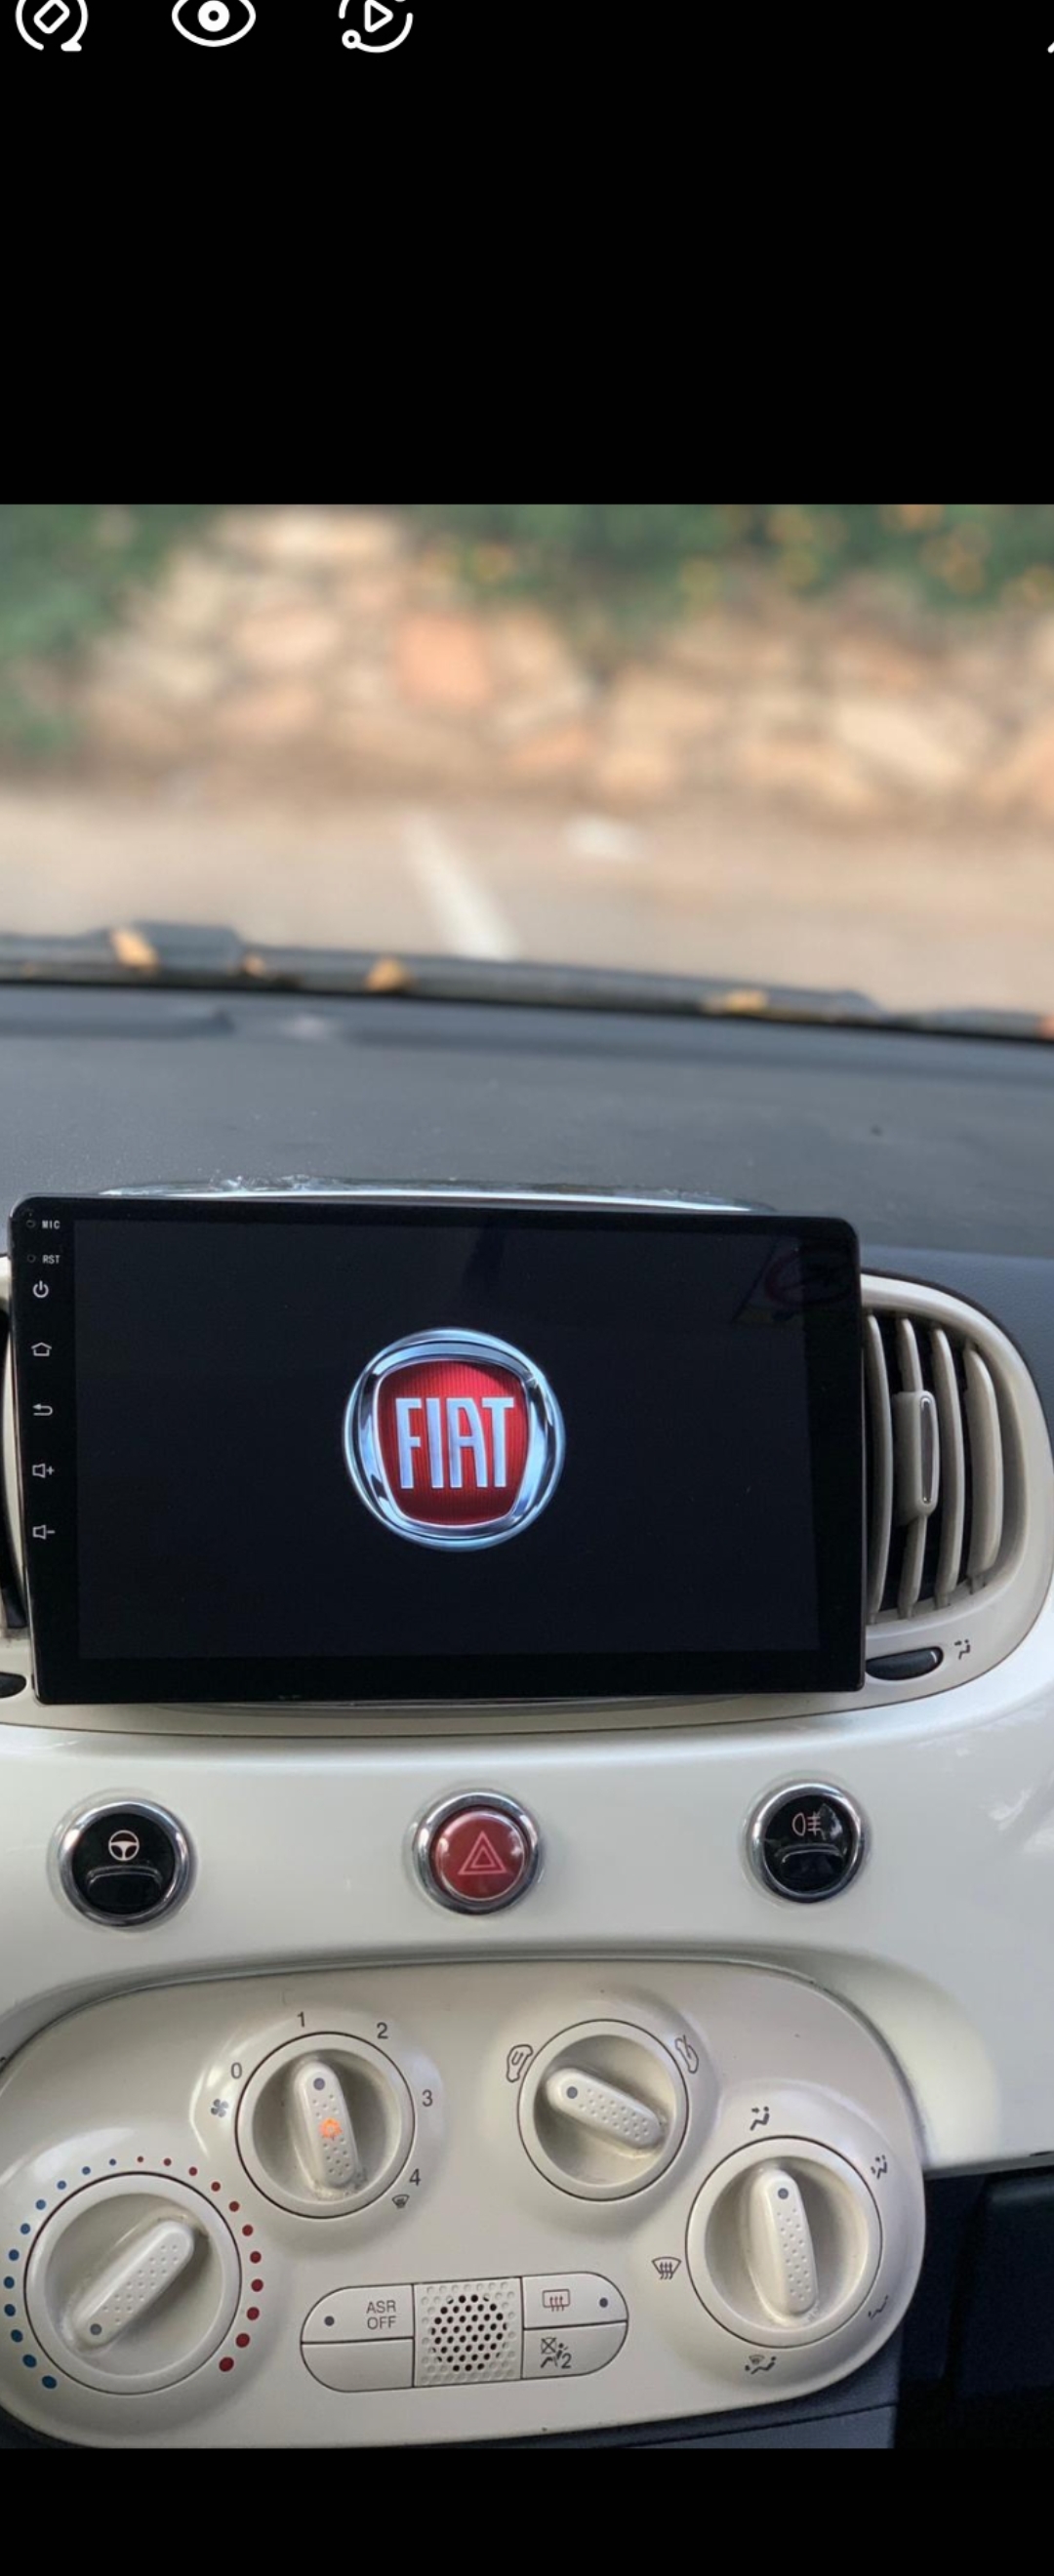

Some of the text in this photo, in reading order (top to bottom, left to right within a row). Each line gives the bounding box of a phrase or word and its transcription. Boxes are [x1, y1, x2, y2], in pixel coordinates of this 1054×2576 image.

[41, 1220, 61, 1229] MIC
[42, 1254, 61, 1265] RST
[395, 1397, 514, 1489] FIAT
[297, 2011, 305, 2028] 1
[377, 2022, 388, 2039] 2
[230, 2062, 243, 2079] 0
[422, 2089, 433, 2107] 3
[409, 2168, 421, 2186] 4
[366, 2300, 396, 2314] ASR
[367, 2315, 396, 2330] OFF
[560, 2354, 572, 2369] 2
